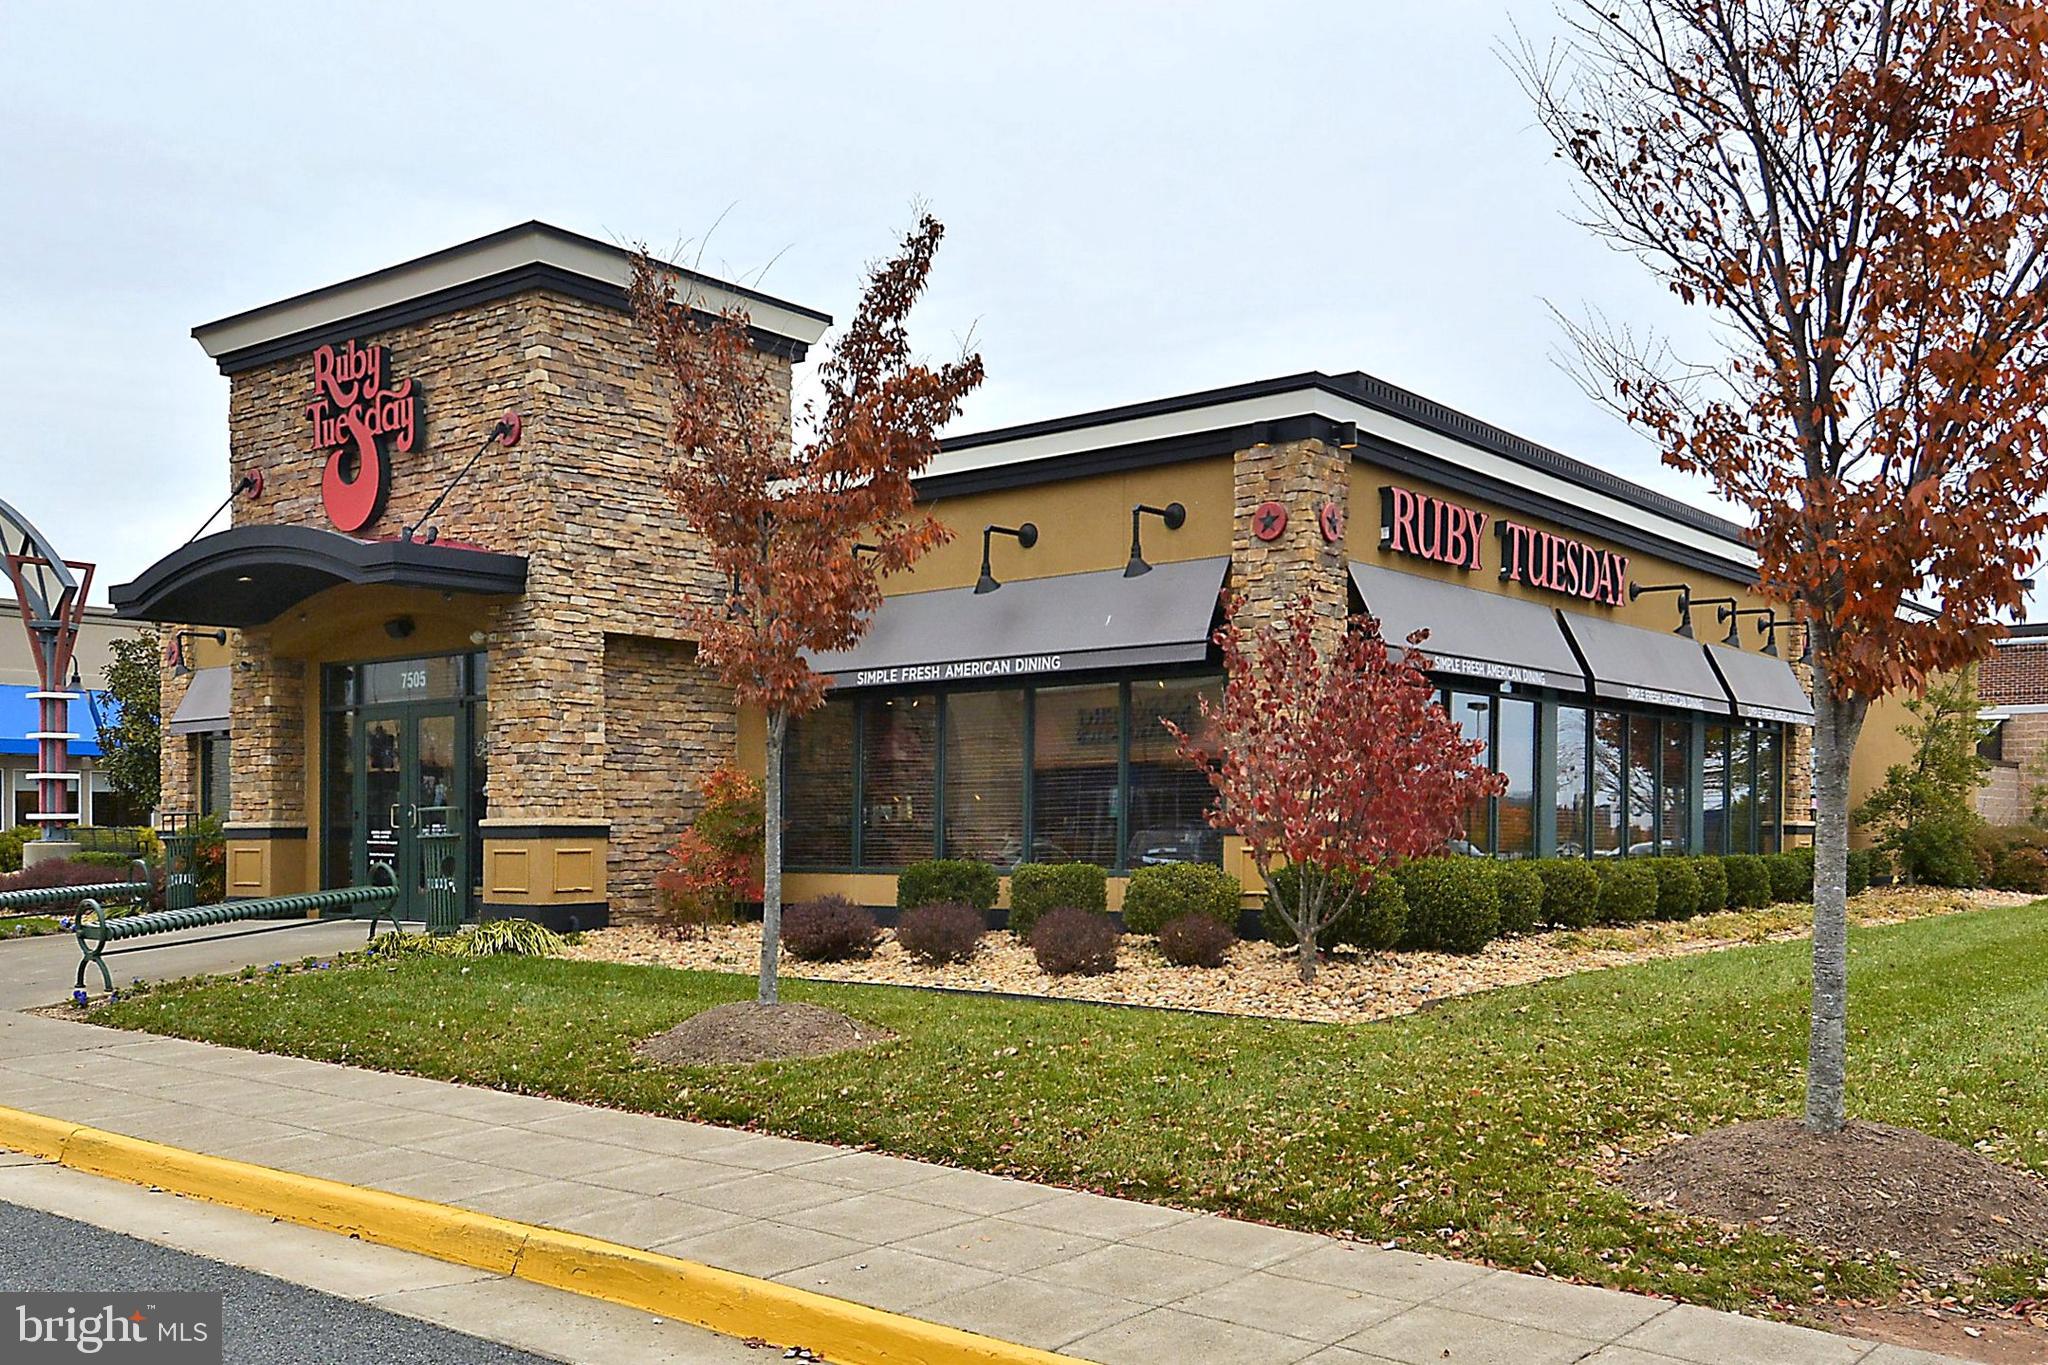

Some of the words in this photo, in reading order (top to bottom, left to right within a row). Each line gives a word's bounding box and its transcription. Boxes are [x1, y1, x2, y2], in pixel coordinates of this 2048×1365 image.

[313, 338, 381, 408] Ruby
[305, 378, 415, 532] Tuesday
[1390, 486, 1489, 570] RUBY
[1505, 520, 1631, 607] TUESDAY
[401, 670, 426, 689] 7505
[857, 668, 898, 686] SIMPLE
[901, 665, 940, 682] FRESH
[944, 659, 1011, 679] AMERICAN
[1015, 655, 1062, 673] DINING
[1434, 655, 1461, 672] SIMPLE
[1461, 659, 1485, 677] FRESH
[1486, 663, 1522, 682] AMERICAN
[1522, 668, 1546, 685] DINING
